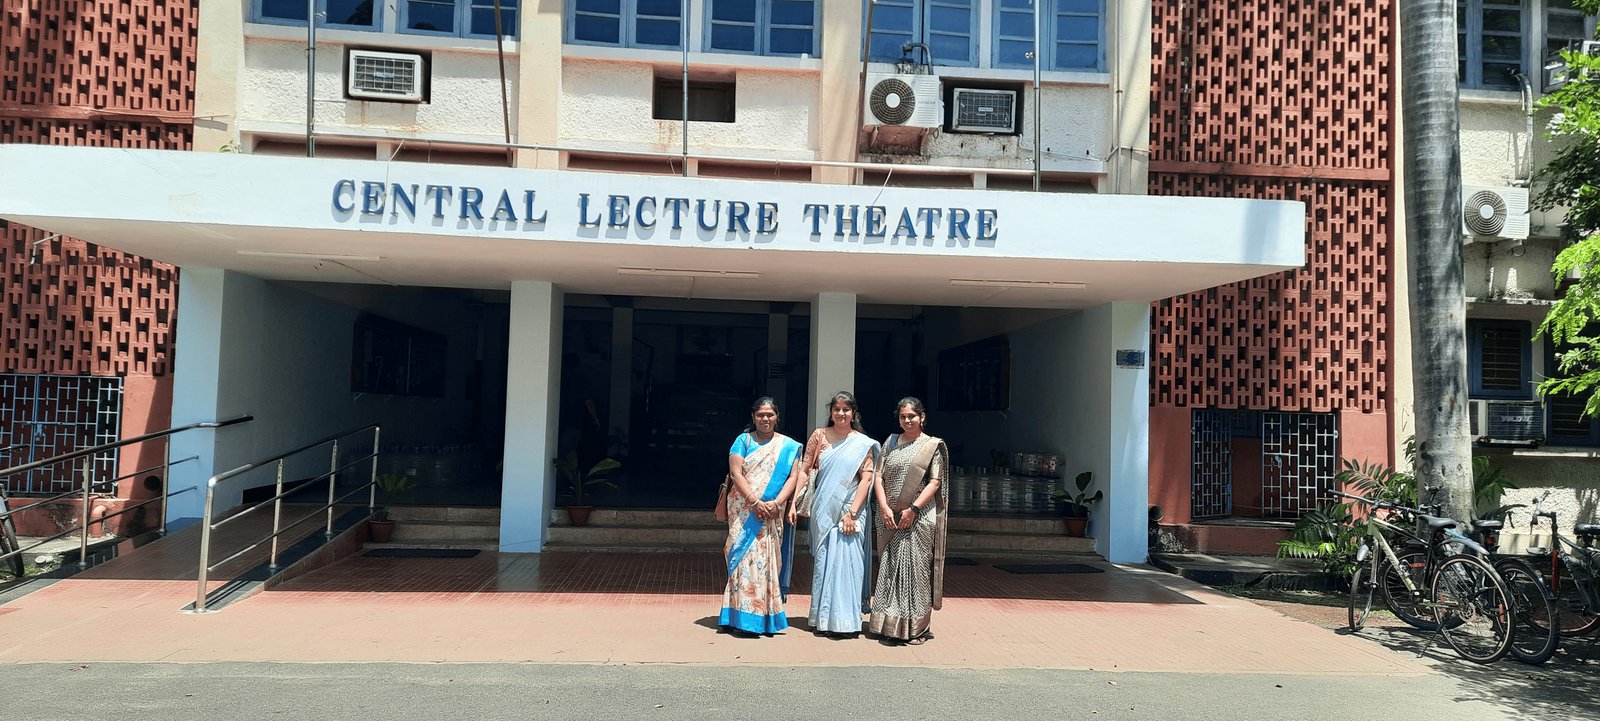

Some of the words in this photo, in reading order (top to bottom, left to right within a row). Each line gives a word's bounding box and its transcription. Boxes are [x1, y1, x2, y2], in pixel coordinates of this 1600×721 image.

[332, 179, 548, 223] CENTRAL
[578, 193, 779, 235] LECTURE
[804, 203, 998, 241] THEATRE
